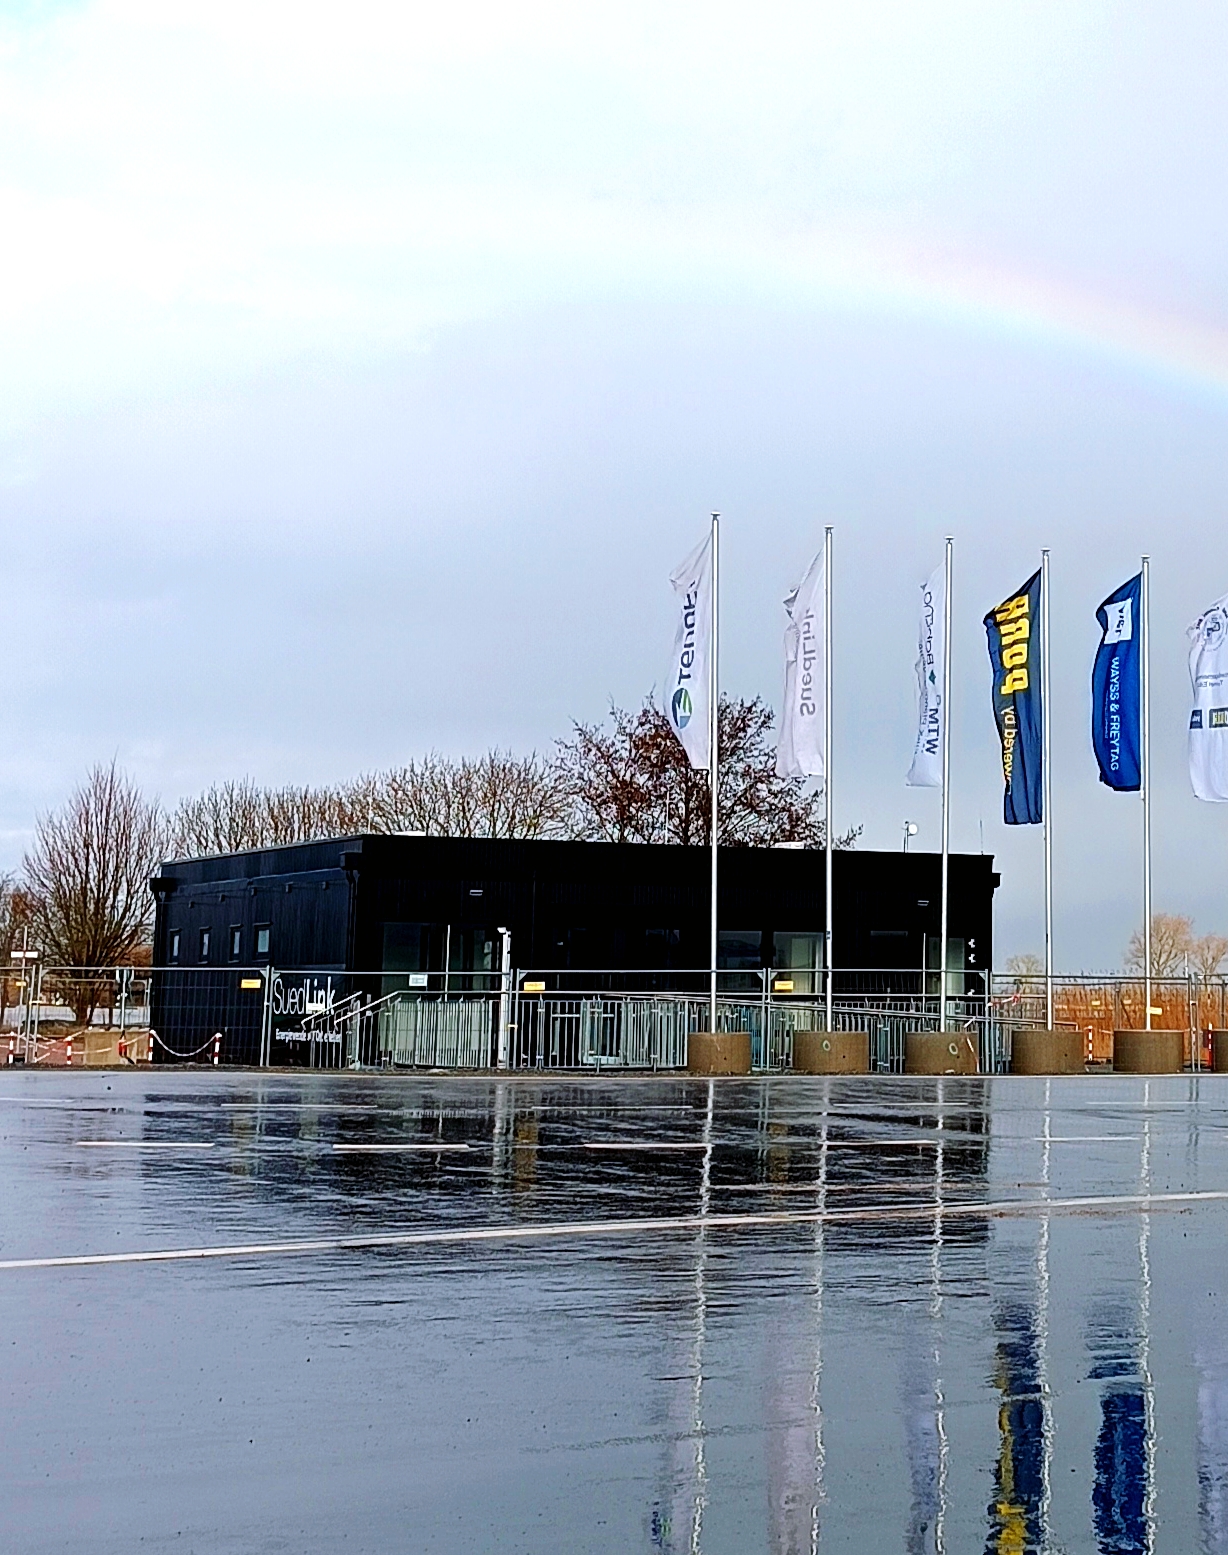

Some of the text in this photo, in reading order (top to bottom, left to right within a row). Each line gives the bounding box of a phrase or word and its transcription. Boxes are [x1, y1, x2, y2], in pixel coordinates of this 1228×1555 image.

[677, 580, 698, 685] Tenn
[1108, 656, 1121, 772] WAYSS & FREYTAG
[272, 976, 336, 1015] SuedLink
